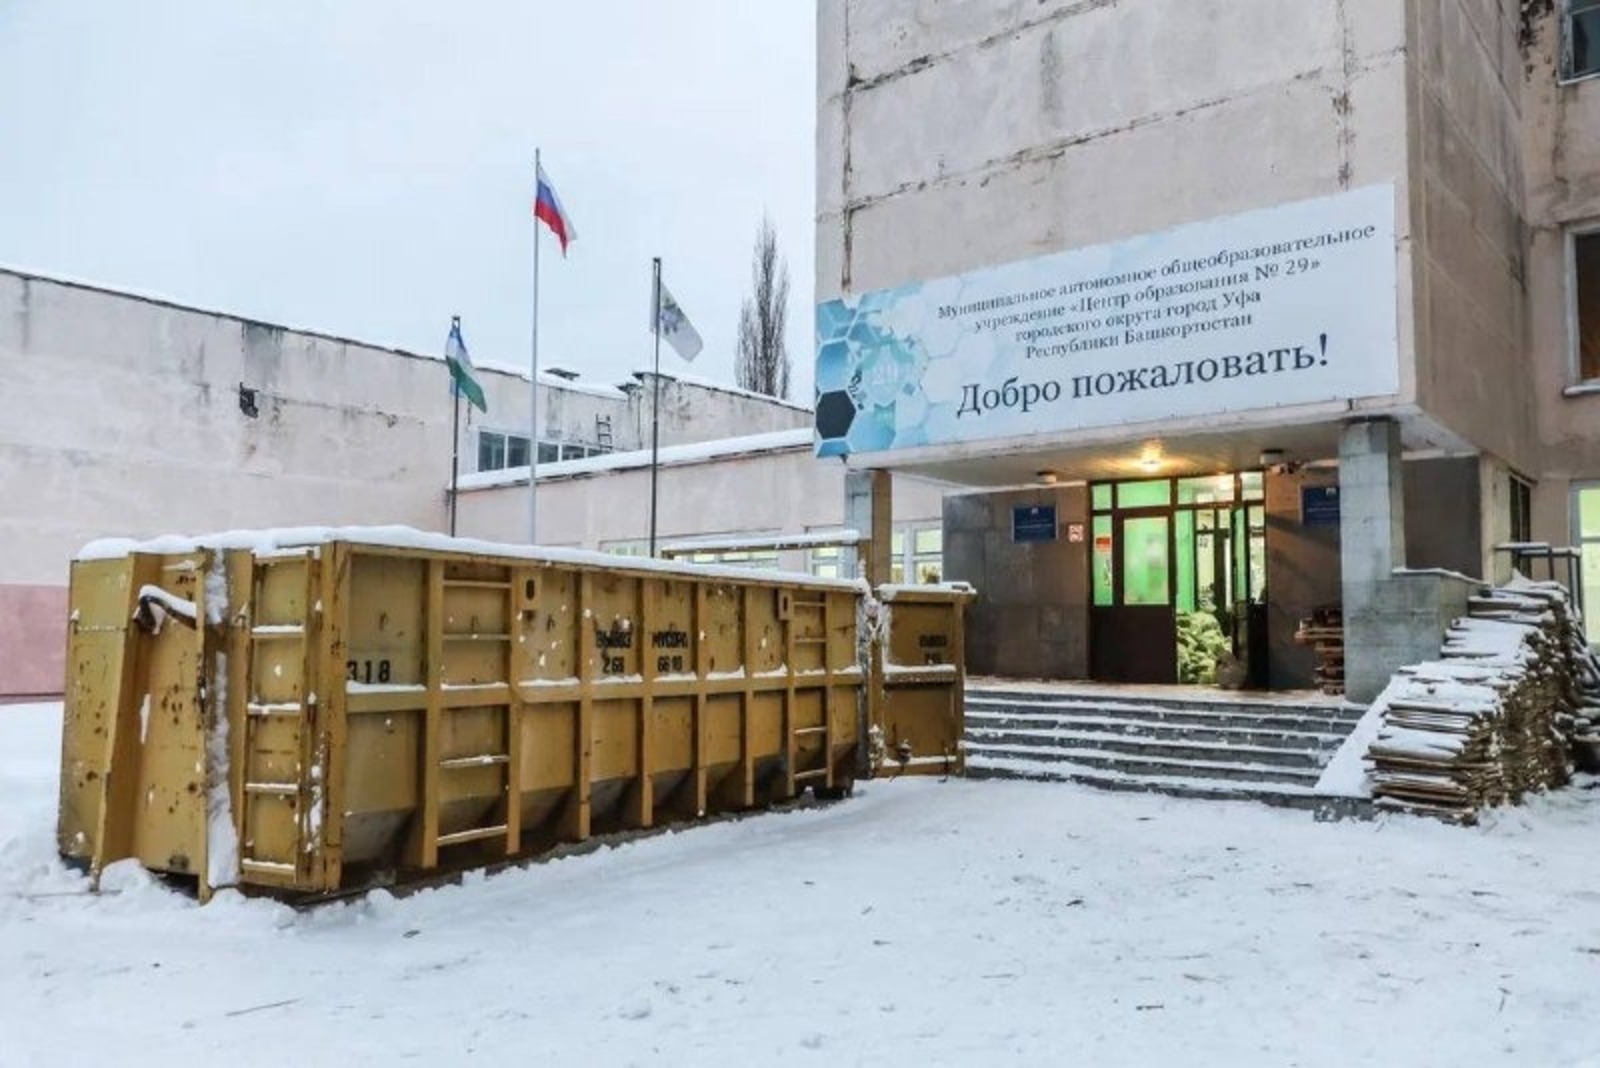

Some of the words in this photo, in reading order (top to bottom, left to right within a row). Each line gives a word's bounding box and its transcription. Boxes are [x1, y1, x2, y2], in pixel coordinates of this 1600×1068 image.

[938, 287, 1057, 320] Муниципальное
[1059, 269, 1157, 296] автономное
[1161, 225, 1375, 276] общеобразовательное
[975, 306, 1065, 334] учреждение
[1070, 293, 1131, 313] «Центр
[1135, 271, 1249, 302] образования
[1255, 262, 1279, 281] №
[1286, 257, 1321, 275] 29»
[1016, 319, 1102, 343] городского
[1105, 309, 1161, 328] округа
[1166, 299, 1217, 318] город
[1223, 289, 1261, 308] Уфа
[1027, 335, 1119, 359] Республики
[1125, 314, 1252, 345] Башкортостан
[957, 376, 1061, 418] Добро
[1072, 332, 1329, 399] пожаловать!
